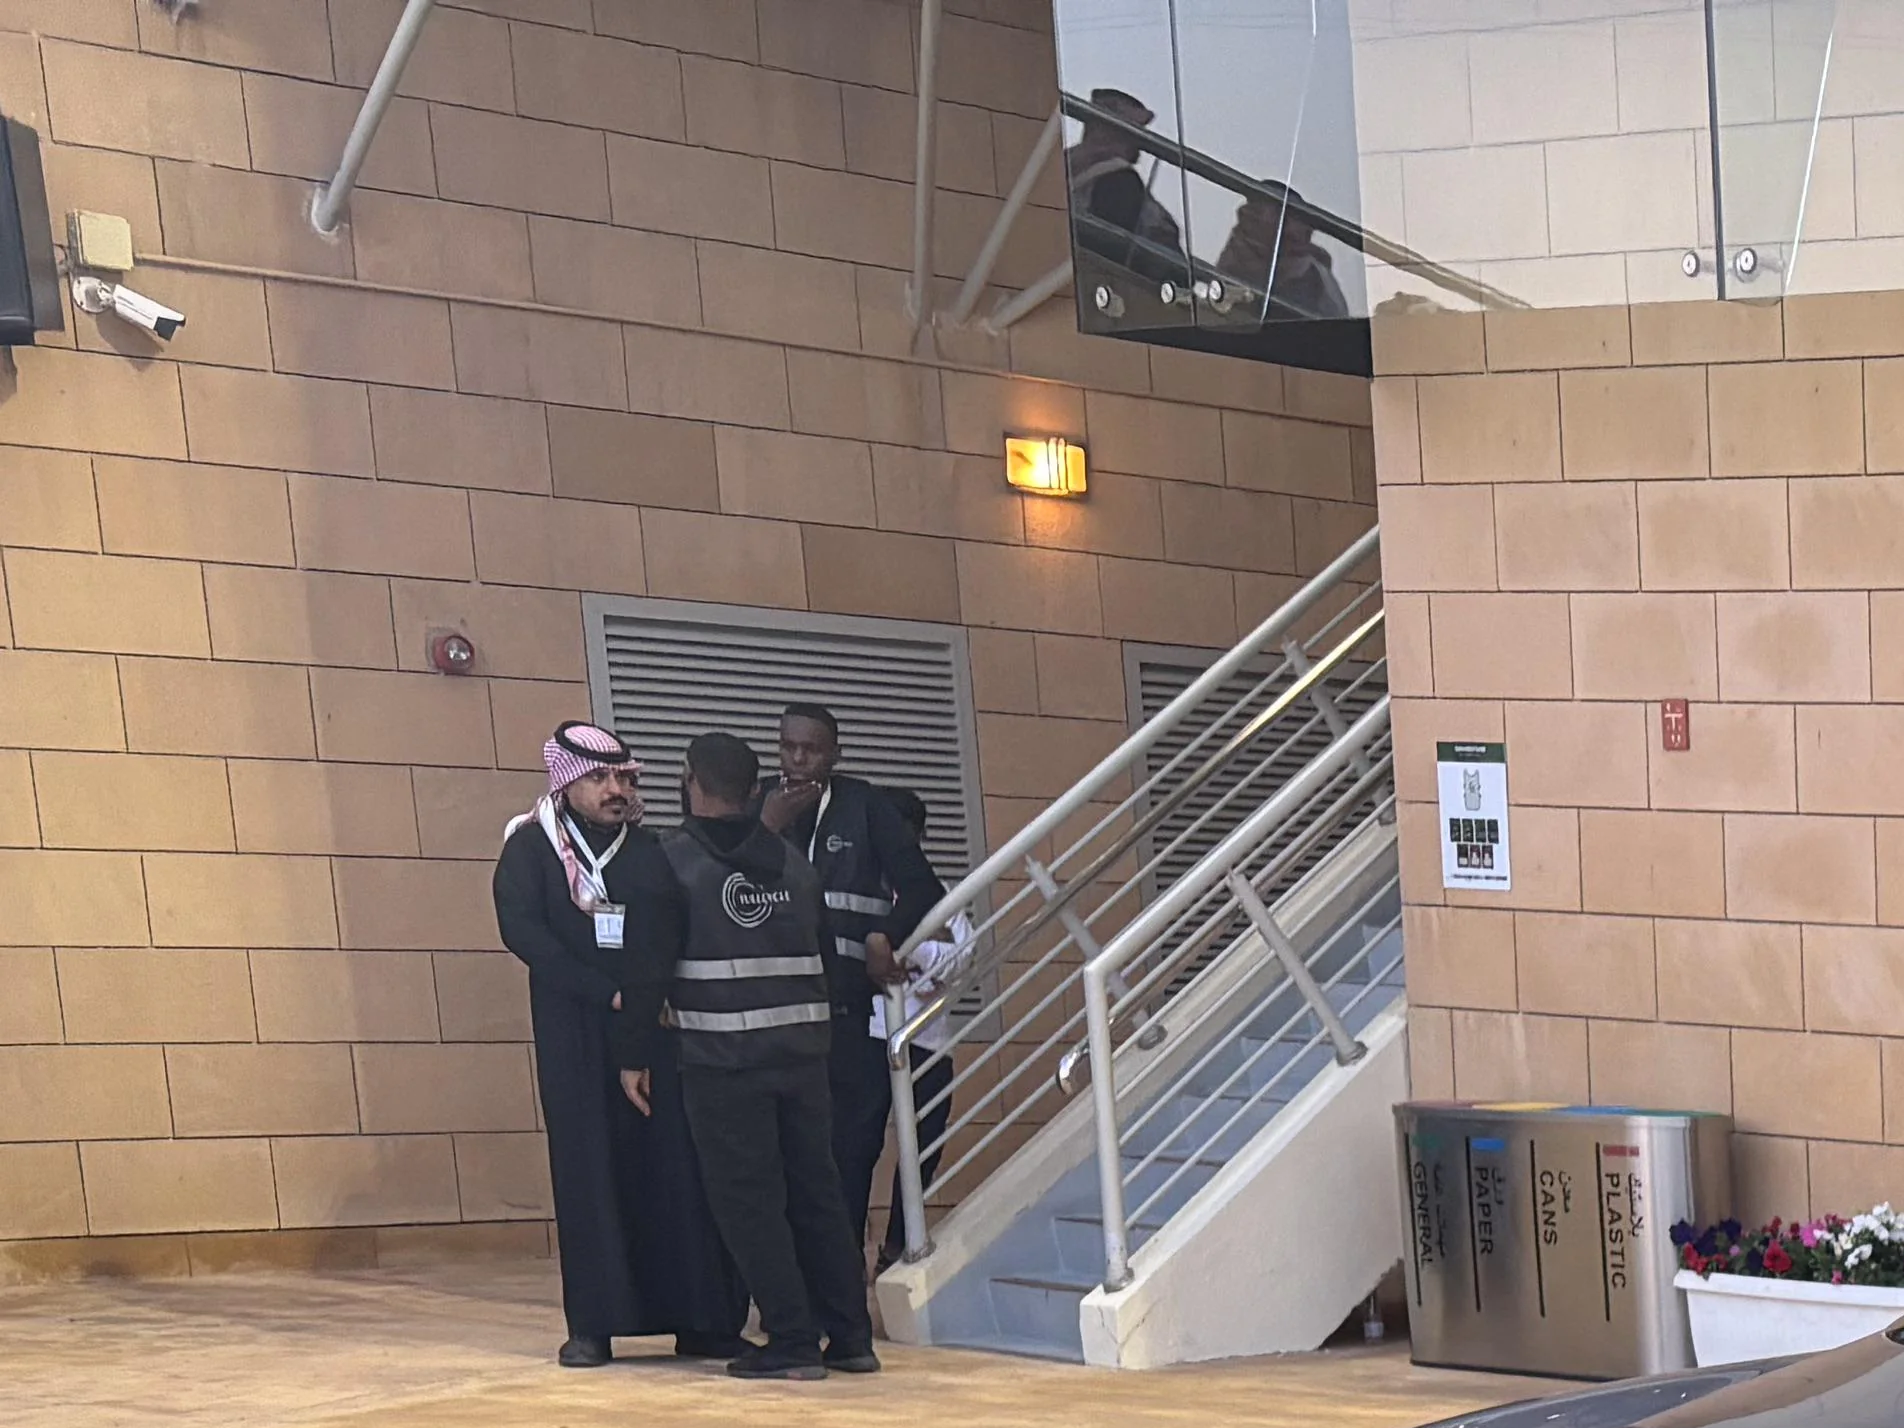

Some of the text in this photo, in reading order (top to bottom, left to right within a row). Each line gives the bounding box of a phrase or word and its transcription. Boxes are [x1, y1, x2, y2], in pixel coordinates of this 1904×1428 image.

[1413, 1160, 1433, 1269] GENERAL
[1474, 1166, 1494, 1255] PAPER
[1539, 1170, 1558, 1246] CANS
[1604, 1172, 1627, 1289] PLASTIC
